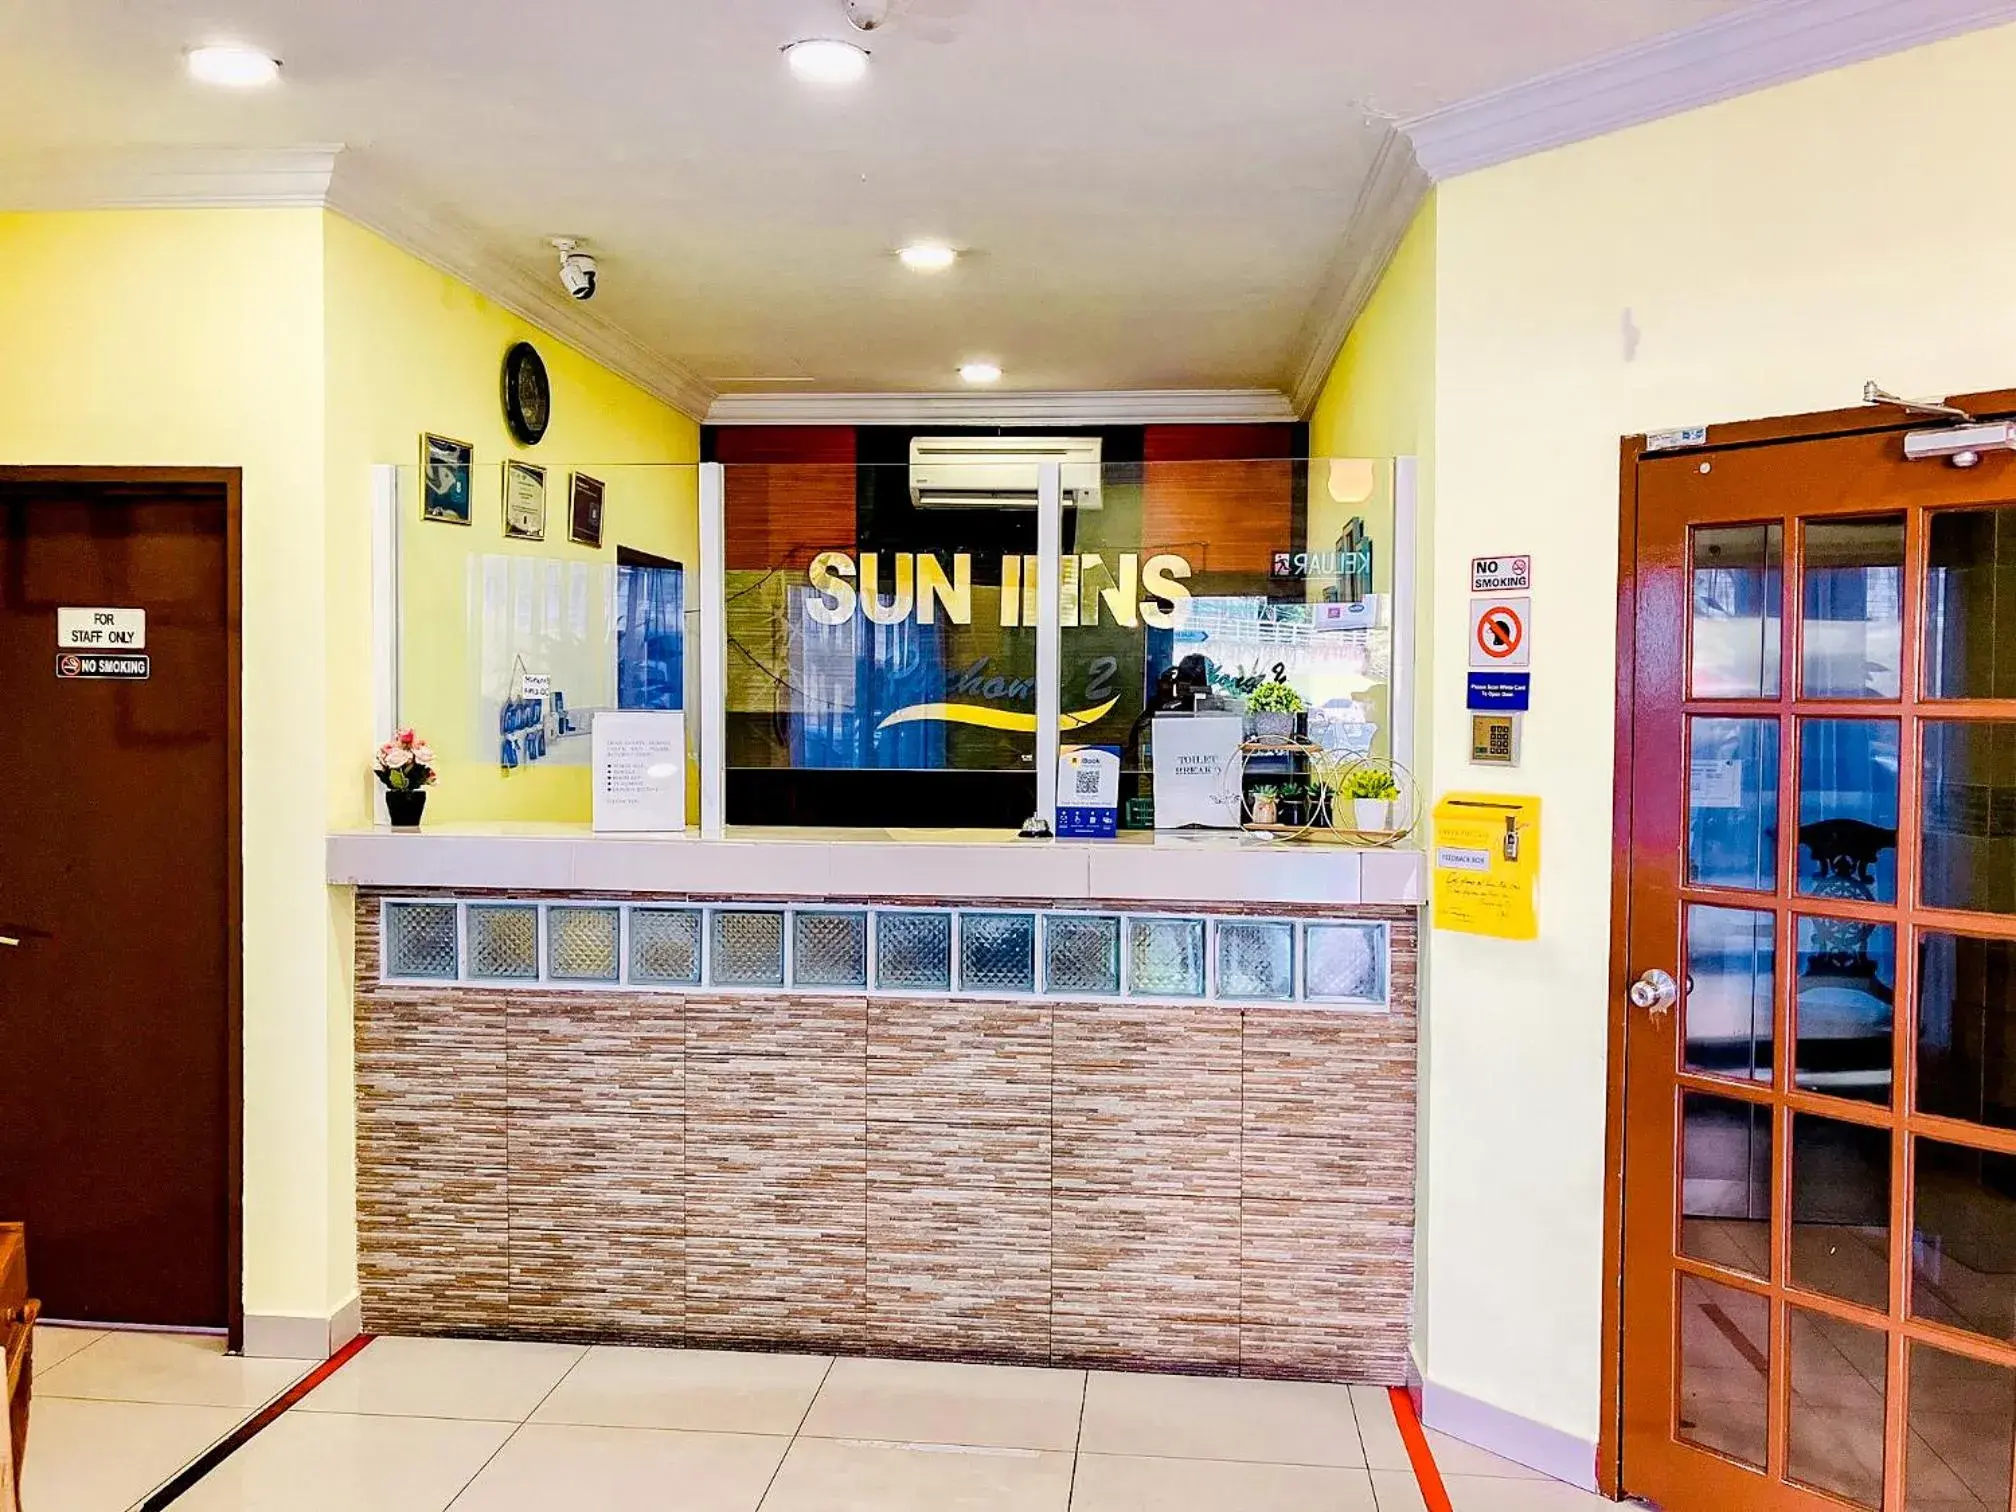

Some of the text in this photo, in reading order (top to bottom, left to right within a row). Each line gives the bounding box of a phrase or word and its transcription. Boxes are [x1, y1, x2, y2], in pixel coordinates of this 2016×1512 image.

[1476, 561, 1498, 574] NO
[805, 551, 971, 625] SUN
[1475, 576, 1526, 588] SMOKING
[94, 613, 114, 625] FOR
[71, 630, 134, 643] STAFF ONLY
[81, 659, 146, 674] NO SMOKING
[1085, 656, 1118, 700] 2
[1177, 755, 1218, 764] TOILET
[1176, 766, 1211, 775] BREAK
[1441, 854, 1485, 864] FEEDBACK BOX
